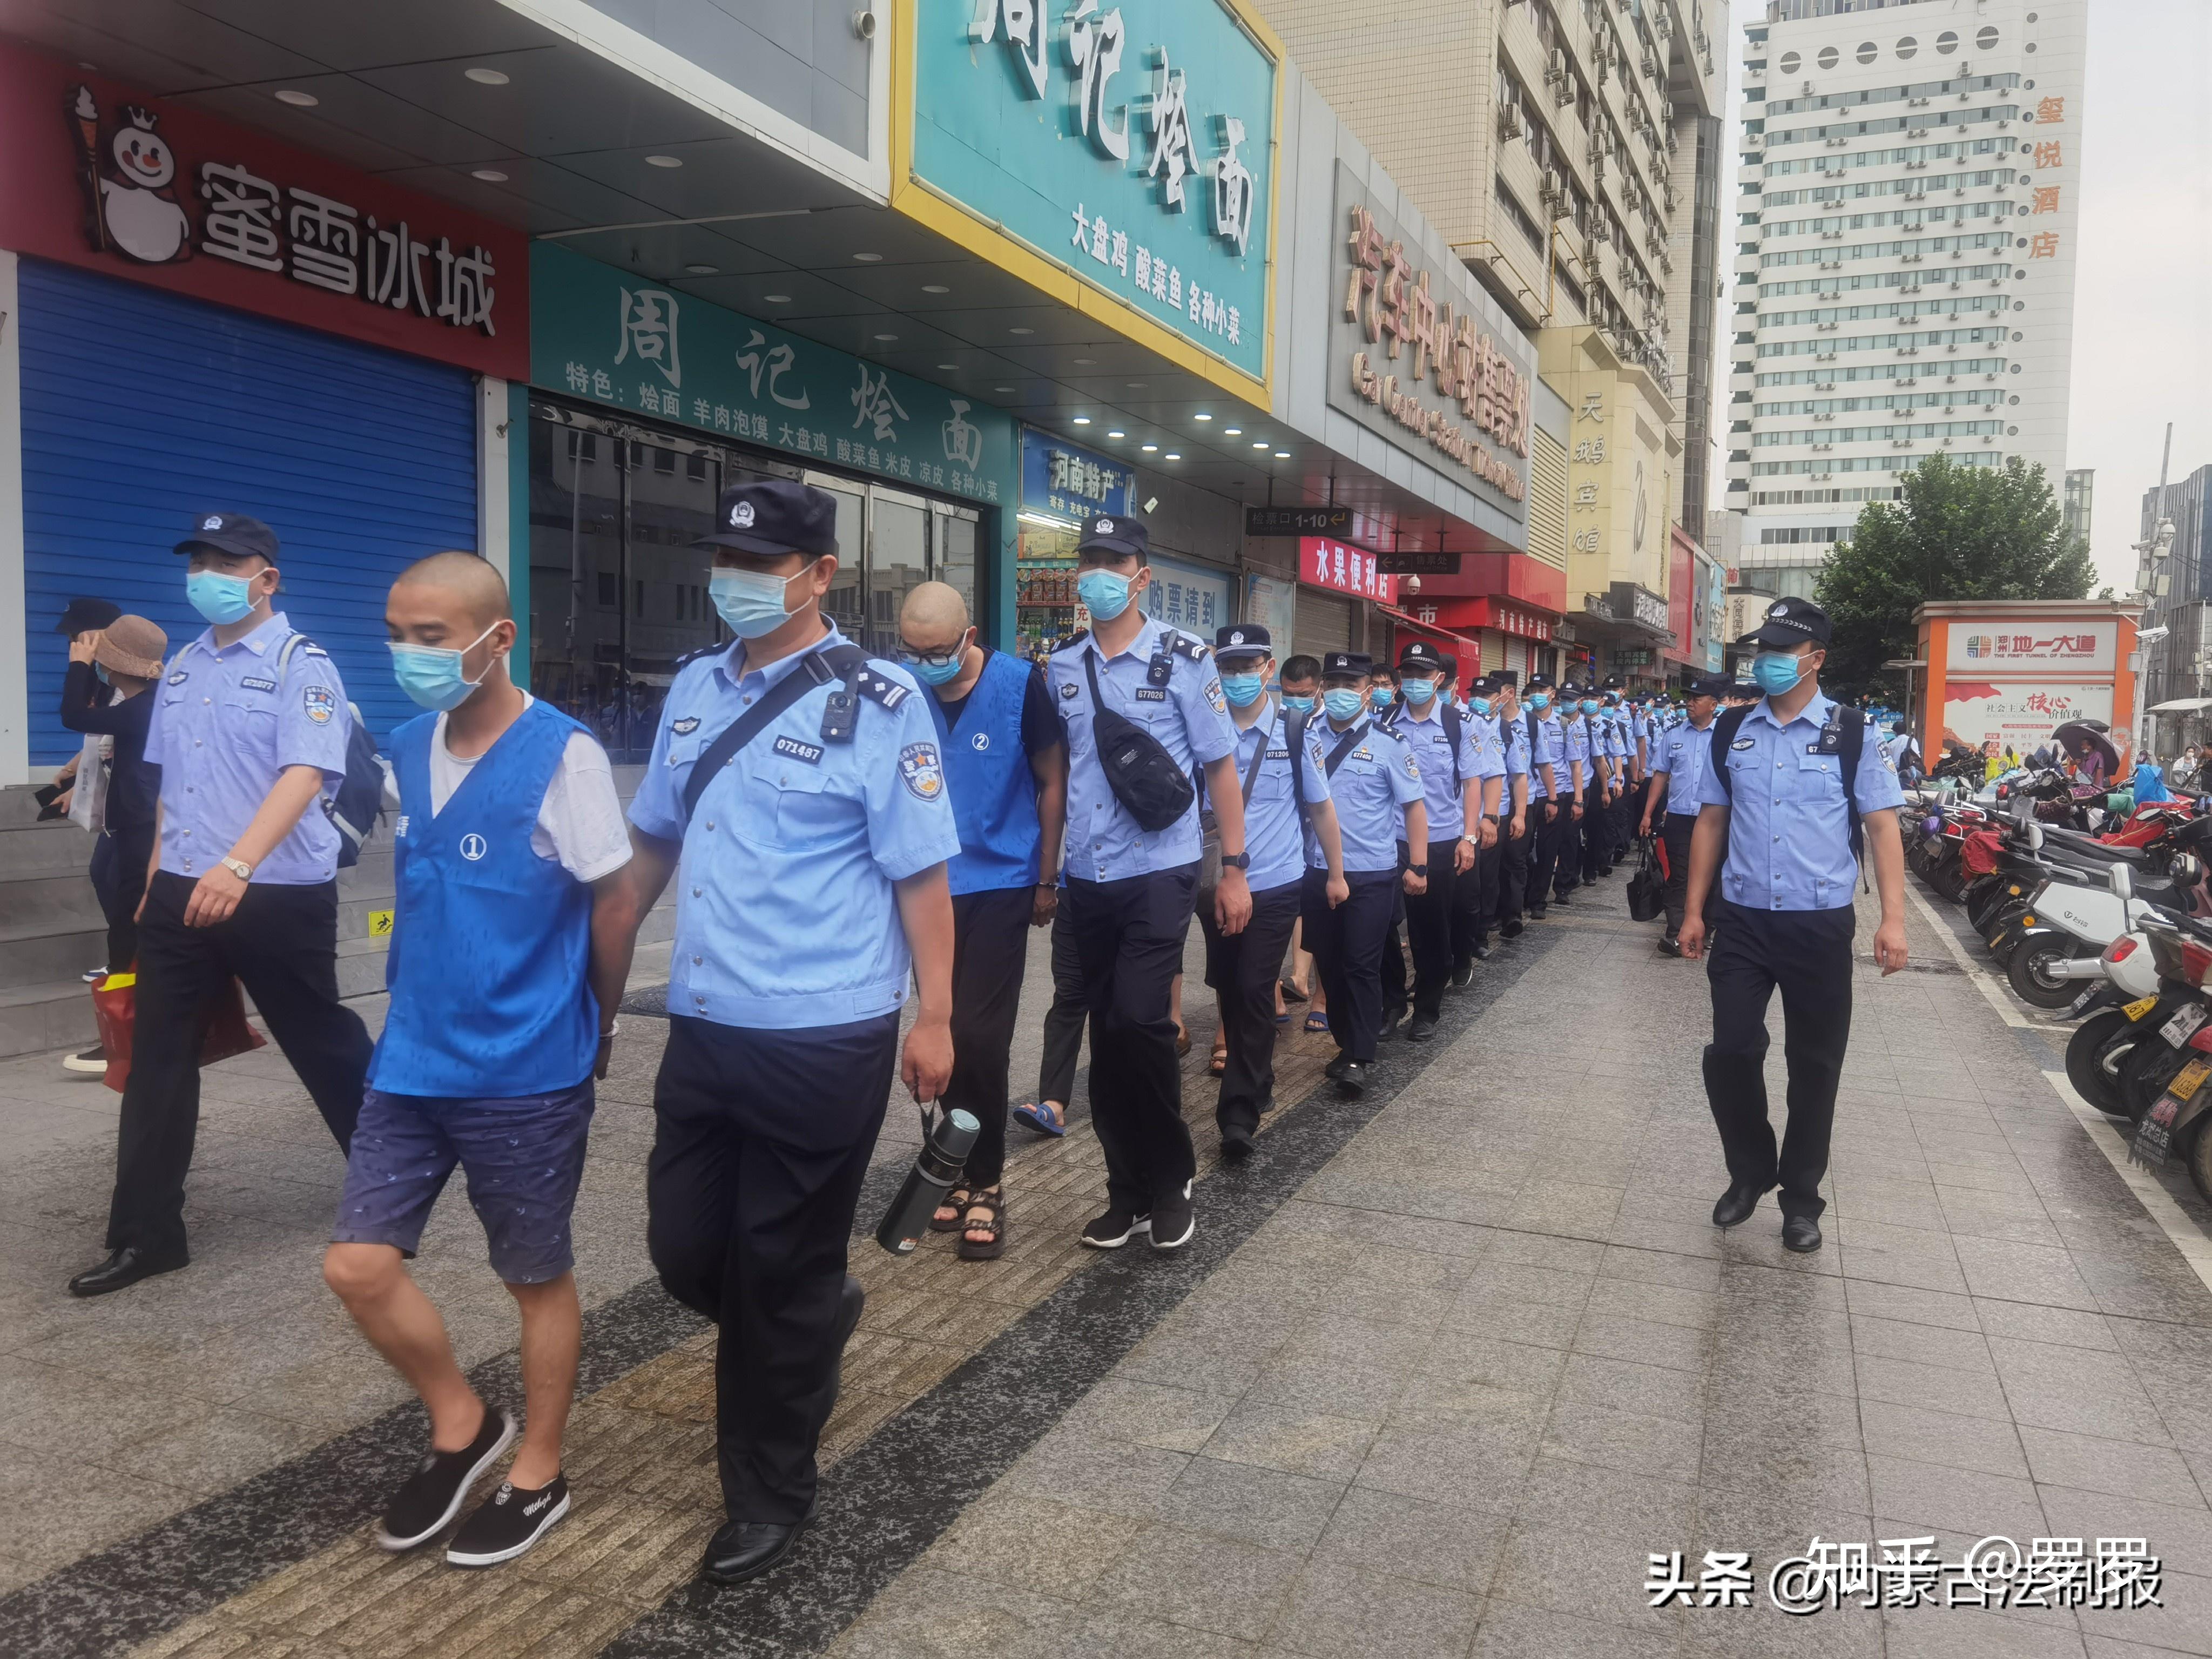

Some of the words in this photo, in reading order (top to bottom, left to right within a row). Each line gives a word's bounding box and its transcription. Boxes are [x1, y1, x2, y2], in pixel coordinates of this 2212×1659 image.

[2029, 96, 2065, 259] 玺悦酒店
[201, 161, 496, 337] 蜜雪冰城
[1071, 203, 1128, 277] 大盘鸡
[1135, 245, 1182, 311] 酸菜鱼
[1188, 280, 1240, 346] 各种小菜
[614, 286, 983, 472] 周记烩面
[1352, 352, 1384, 405] Car
[639, 381, 680, 419] 烩面
[693, 398, 769, 442] 羊肉泡馍
[779, 422, 828, 457] 大盘鸡
[837, 437, 881, 471] 酸菜鱼
[886, 452, 912, 478] 米皮
[919, 461, 945, 488] 凉皮
[951, 469, 999, 501] 各种小菜
[1049, 449, 1115, 503] 河南特产
[1573, 392, 1607, 554] 天鹅宾馆
[1049, 495, 1065, 511] 寄存
[1070, 501, 1090, 518] 充电宝
[1252, 512, 1290, 524] 检票口
[1296, 515, 1327, 528] 1-10
[1317, 541, 1388, 599] 水果便利店
[1149, 579, 1215, 629] 购票请到
[1732, 596, 1745, 641] 大同宾馆
[2012, 635, 2096, 652] 地一大道
[1138, 690, 1164, 699] 677026
[1987, 704, 2026, 713] 社会主义
[2027, 692, 2072, 714] 核心
[2048, 709, 2082, 720] 价值观
[777, 739, 820, 760] 071487
